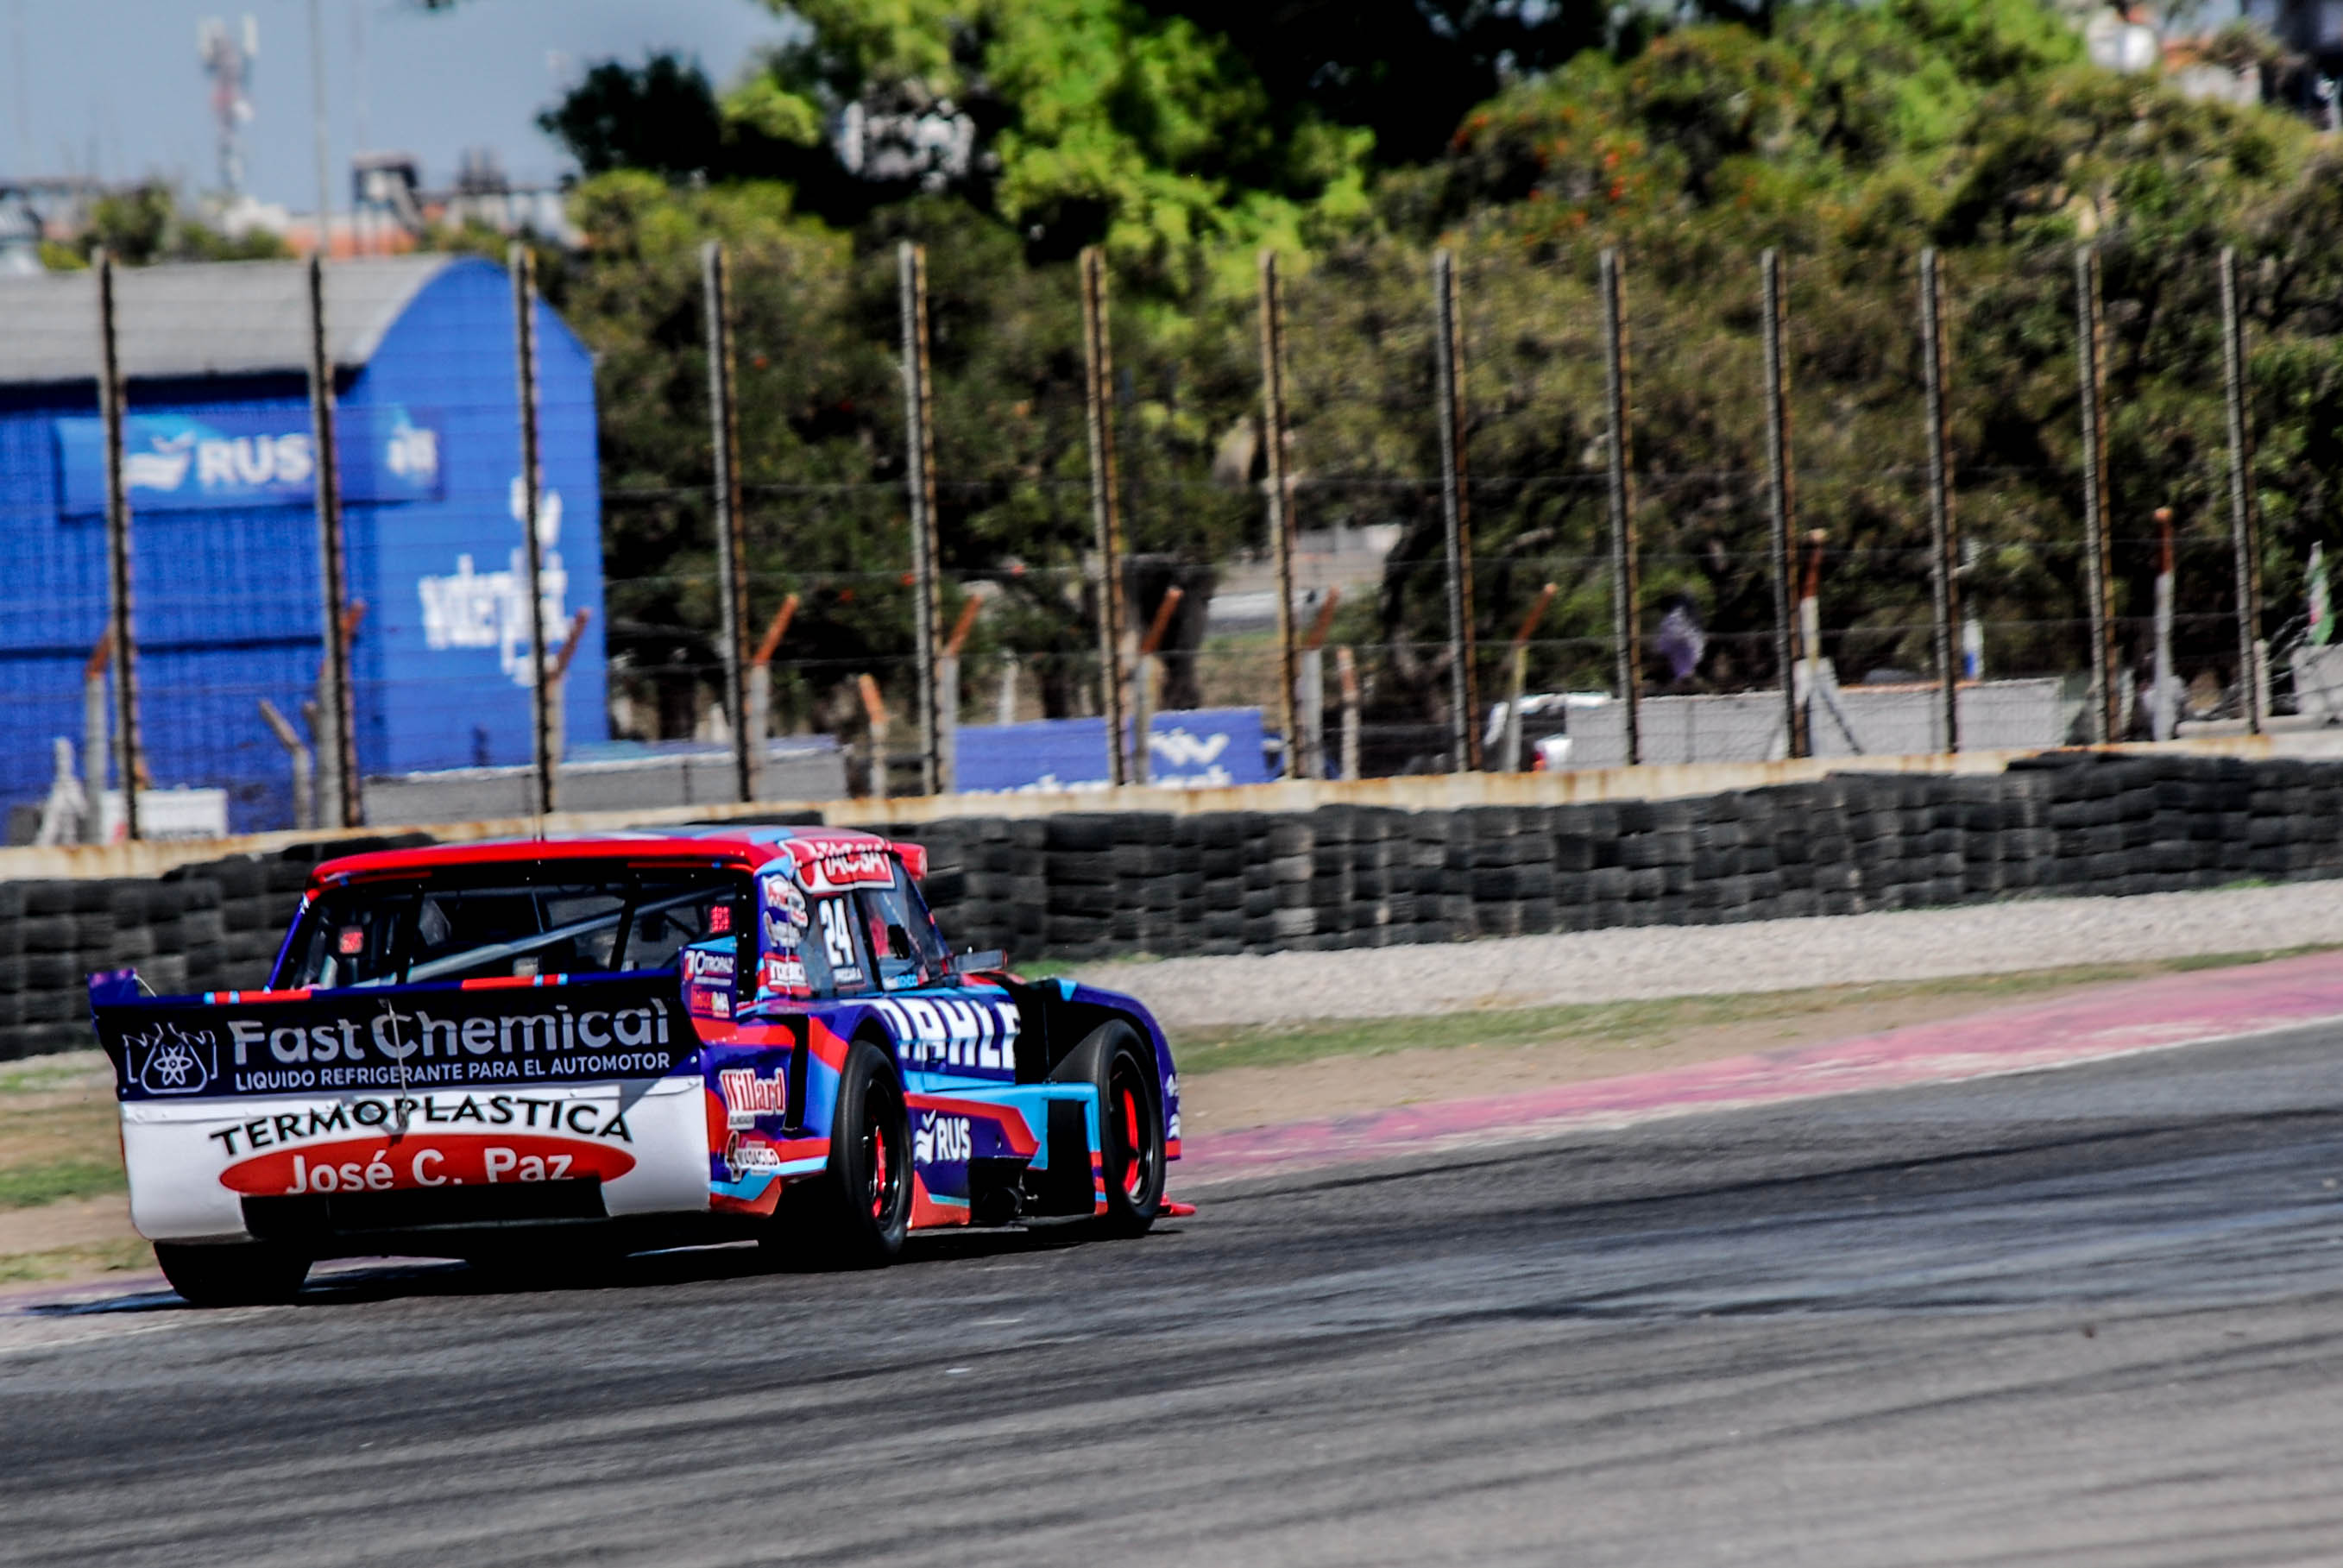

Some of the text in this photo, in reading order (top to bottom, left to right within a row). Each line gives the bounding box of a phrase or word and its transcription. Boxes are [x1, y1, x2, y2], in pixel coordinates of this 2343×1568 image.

[198, 433, 314, 484] RUS
[818, 897, 855, 967] 24
[235, 1052, 671, 1092] LIQUIDO REFRIGERANTE PARA EL AUTOMOTOR
[719, 1067, 786, 1114] Willard
[210, 1094, 634, 1156] TERMOPLASTICA
[935, 1117, 973, 1162] RUS
[285, 1147, 574, 1195] José C. Paz
